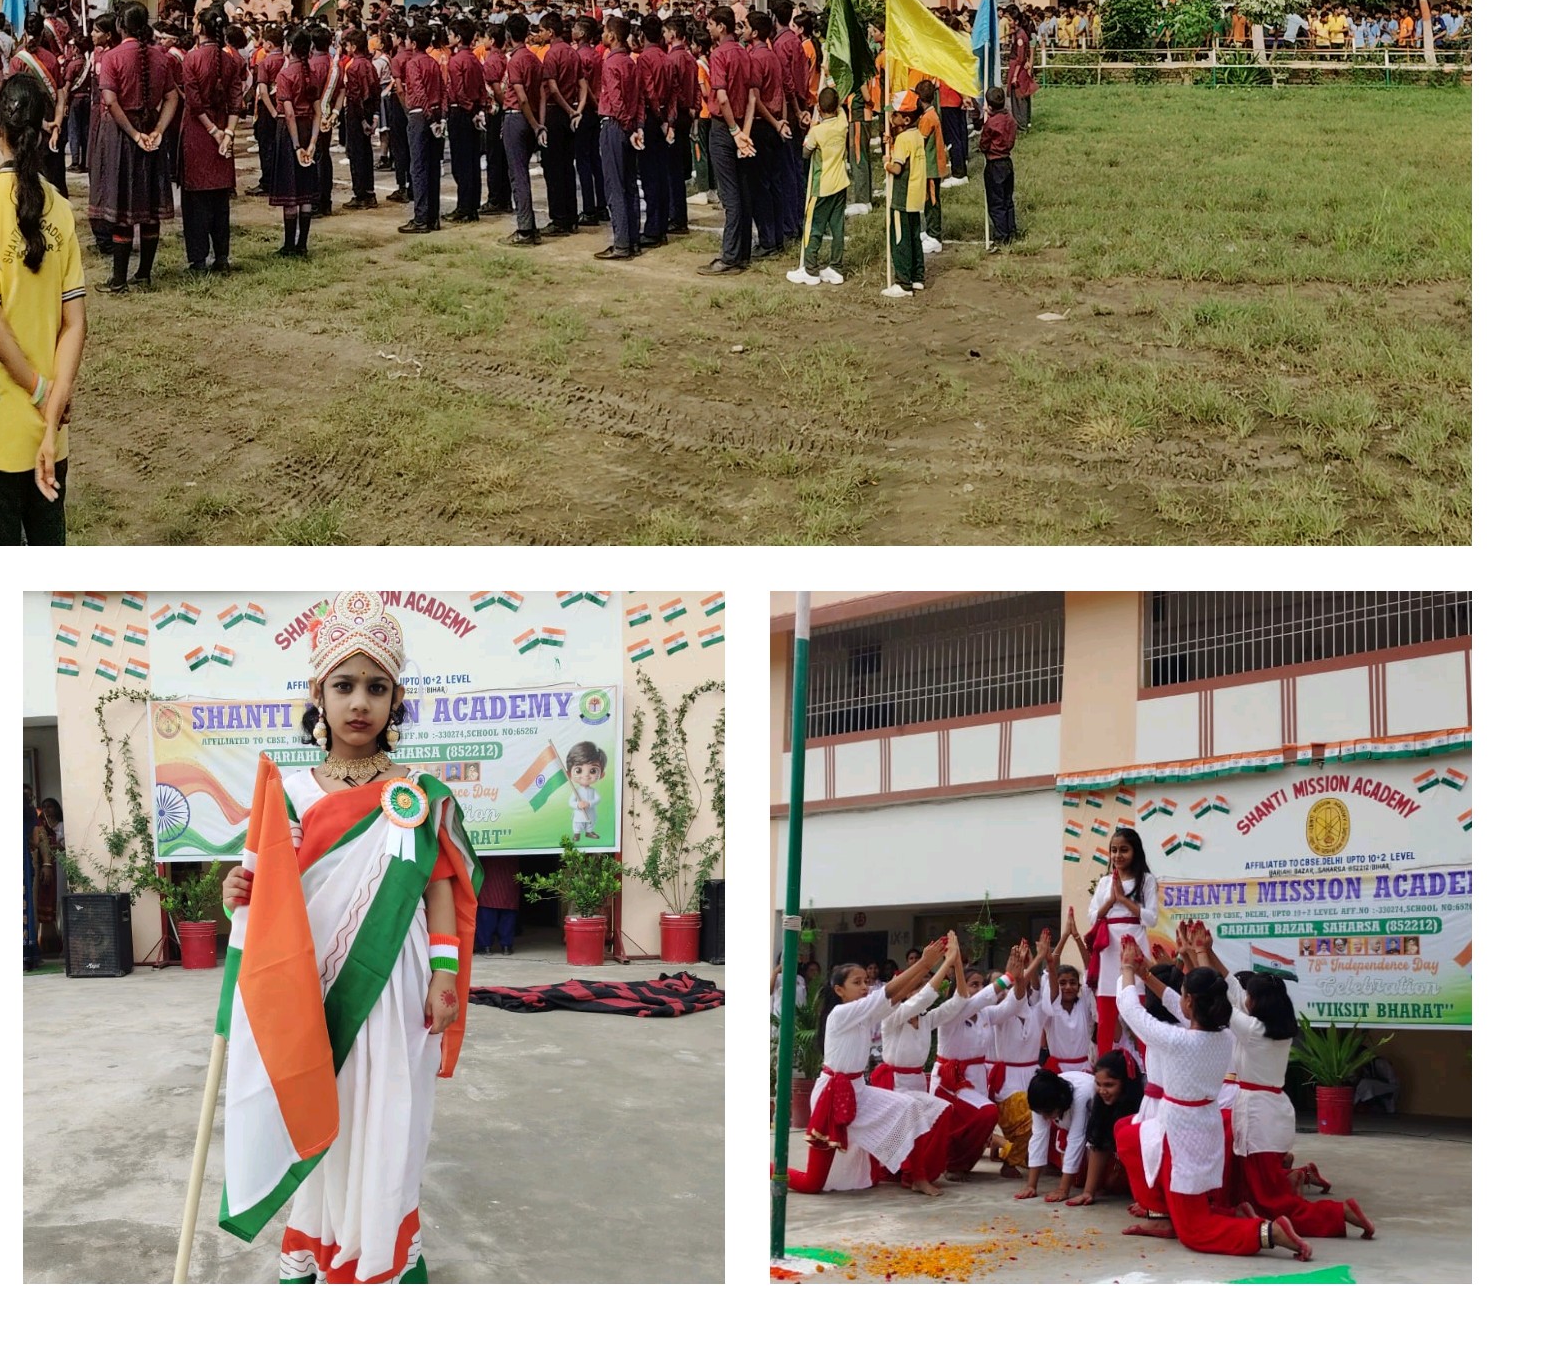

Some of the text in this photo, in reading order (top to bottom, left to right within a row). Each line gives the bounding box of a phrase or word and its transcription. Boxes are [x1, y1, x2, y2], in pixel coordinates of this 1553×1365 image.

[404, 591, 477, 639] ACADEMY
[423, 676, 442, 685] 10+2
[446, 674, 472, 684] LEVEL
[192, 704, 293, 730] SHANTI
[433, 692, 573, 722] ACADEMY
[202, 737, 250, 746] AFFILIATED
[253, 737, 264, 745] TO
[502, 727, 539, 736] NO:65267
[388, 746, 441, 762] AHARSA
[446, 743, 499, 760] (852212)
[473, 784, 499, 800] Day
[1236, 789, 1288, 836] SHANTI
[1293, 775, 1351, 800] MISSION
[1351, 777, 1421, 819] ACADEMY
[1245, 860, 1287, 870] AFFILIATED
[1289, 859, 1298, 868] TO
[1346, 856, 1365, 864] UPTO
[1368, 854, 1386, 862] 10+2
[1390, 852, 1415, 861] LEVEL
[1164, 871, 1472, 907] SHANTI MISSION ACADE
[1272, 910, 1290, 918] UPTO
[1313, 907, 1338, 916] LEVEL
[1221, 919, 1438, 936] BARIAHI BAZAR, SAHARSA (852212)
[1331, 957, 1408, 975] Independence
[1412, 957, 1439, 975] Day
[1316, 976, 1441, 997] Celebration
